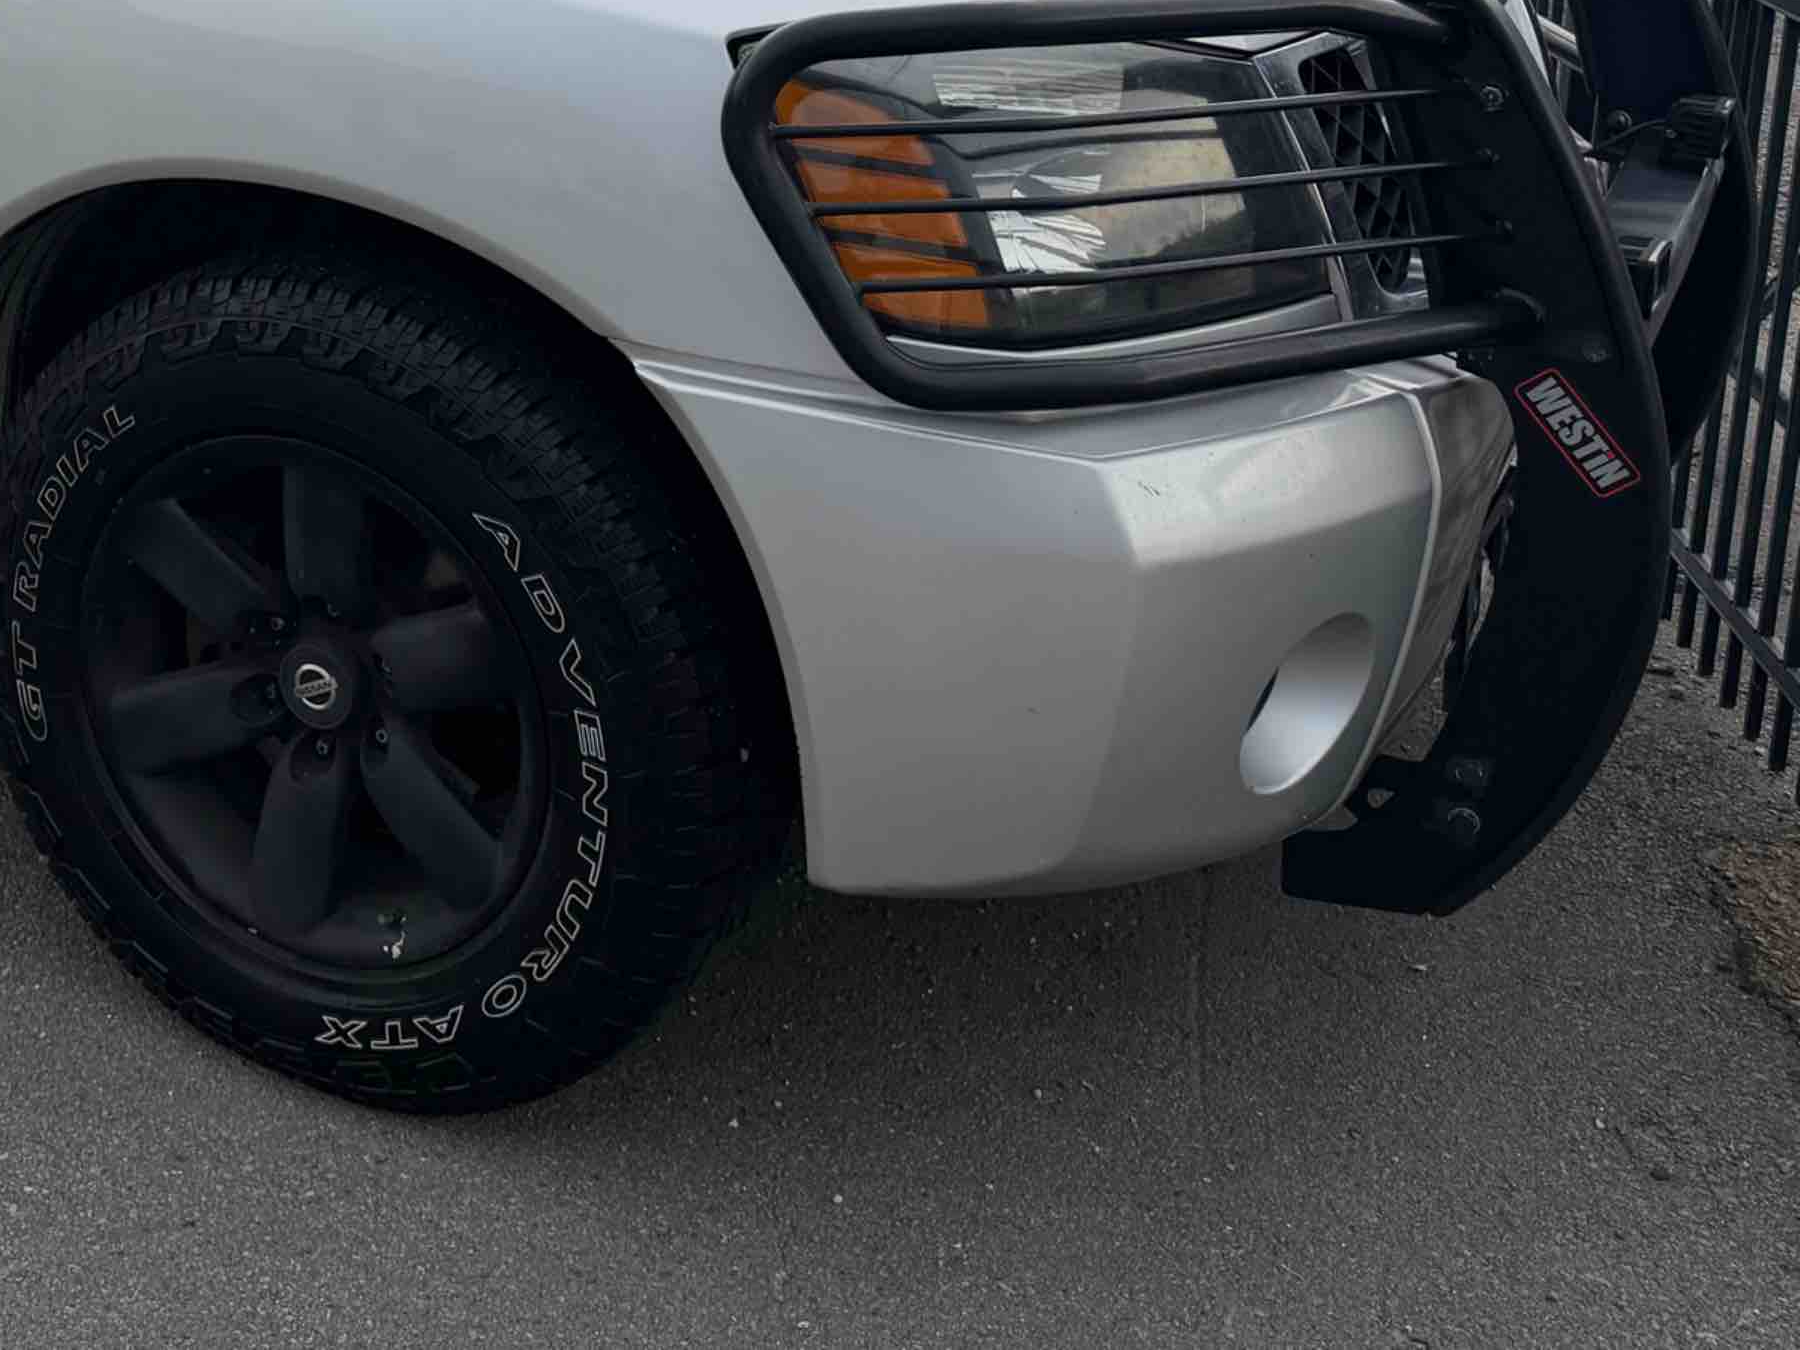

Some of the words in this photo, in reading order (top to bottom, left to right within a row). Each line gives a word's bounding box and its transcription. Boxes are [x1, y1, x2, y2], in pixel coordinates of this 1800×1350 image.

[12, 406, 136, 612] RADIAL
[12, 622, 48, 742] GT
[472, 512, 609, 1018] ADVENTURO
[314, 1004, 466, 1050] ATX
